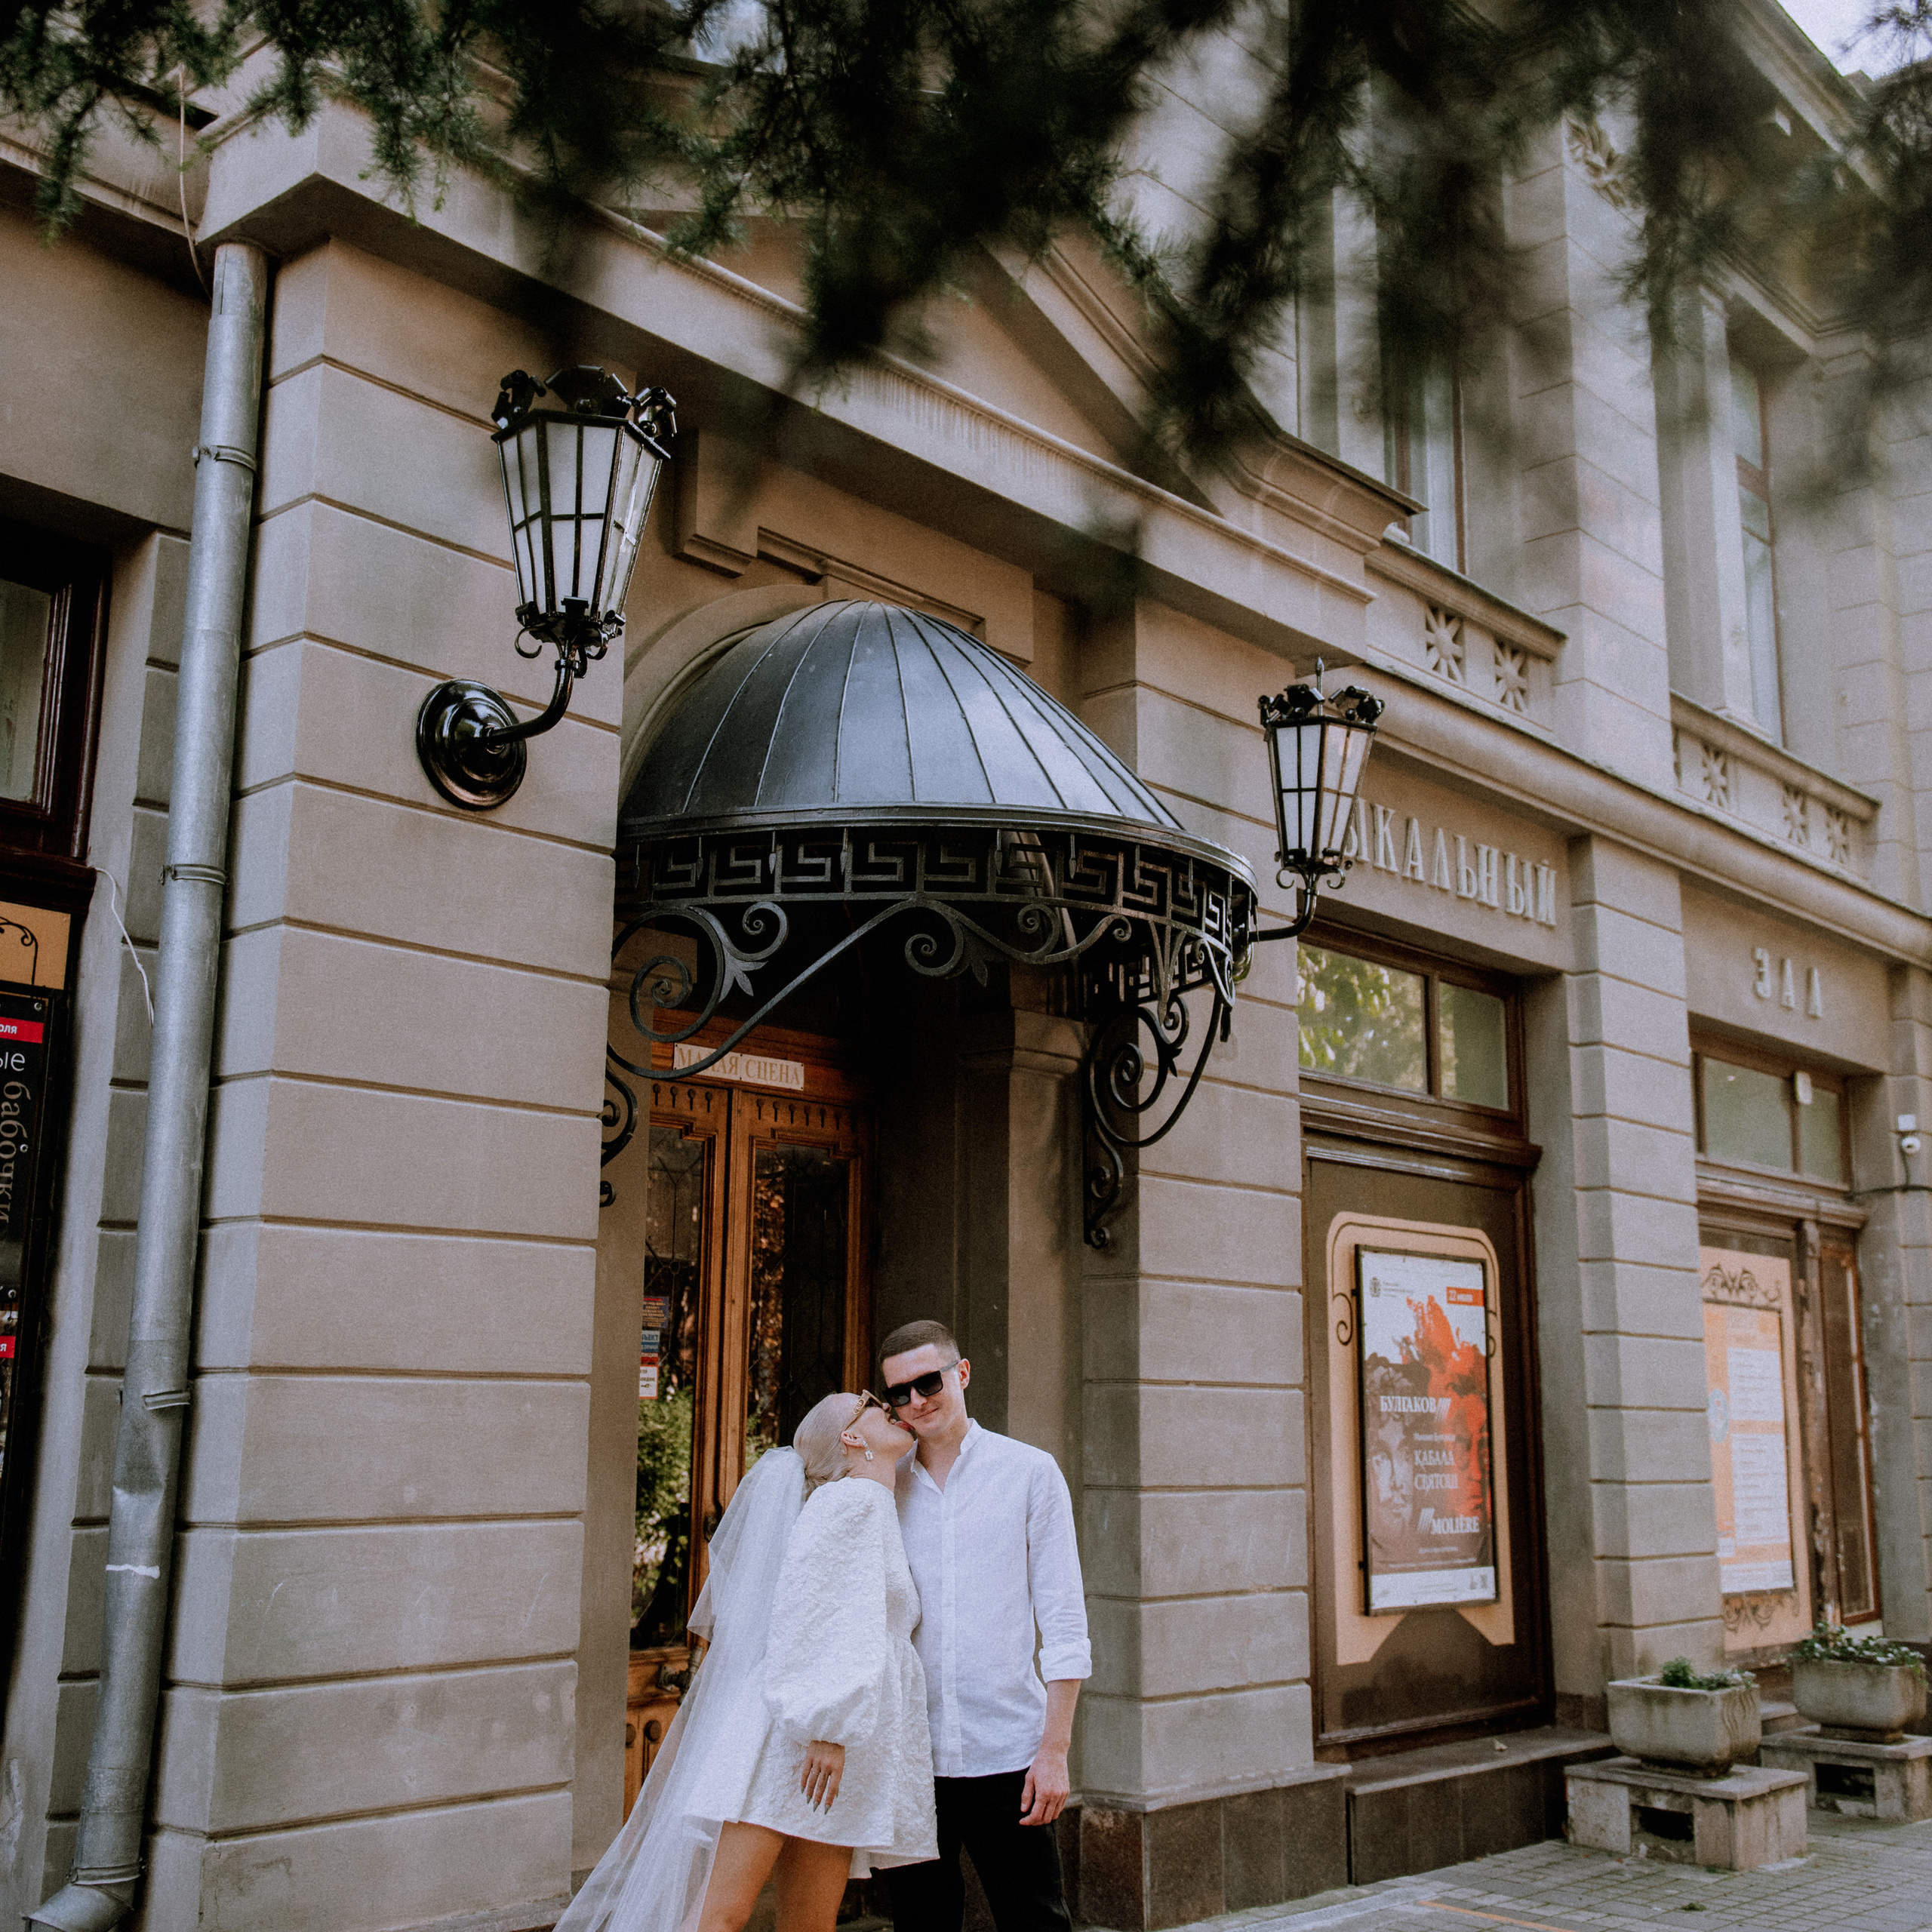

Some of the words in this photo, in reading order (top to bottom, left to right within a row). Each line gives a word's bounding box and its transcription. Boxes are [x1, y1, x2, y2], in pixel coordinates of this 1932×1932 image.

[1755, 947, 1823, 1016] ЗАЛ
[678, 1048, 739, 1075] МААЯ
[745, 1060, 800, 1085] СЦЕНА
[1380, 1395, 1436, 1413] БУЛГАКОВ
